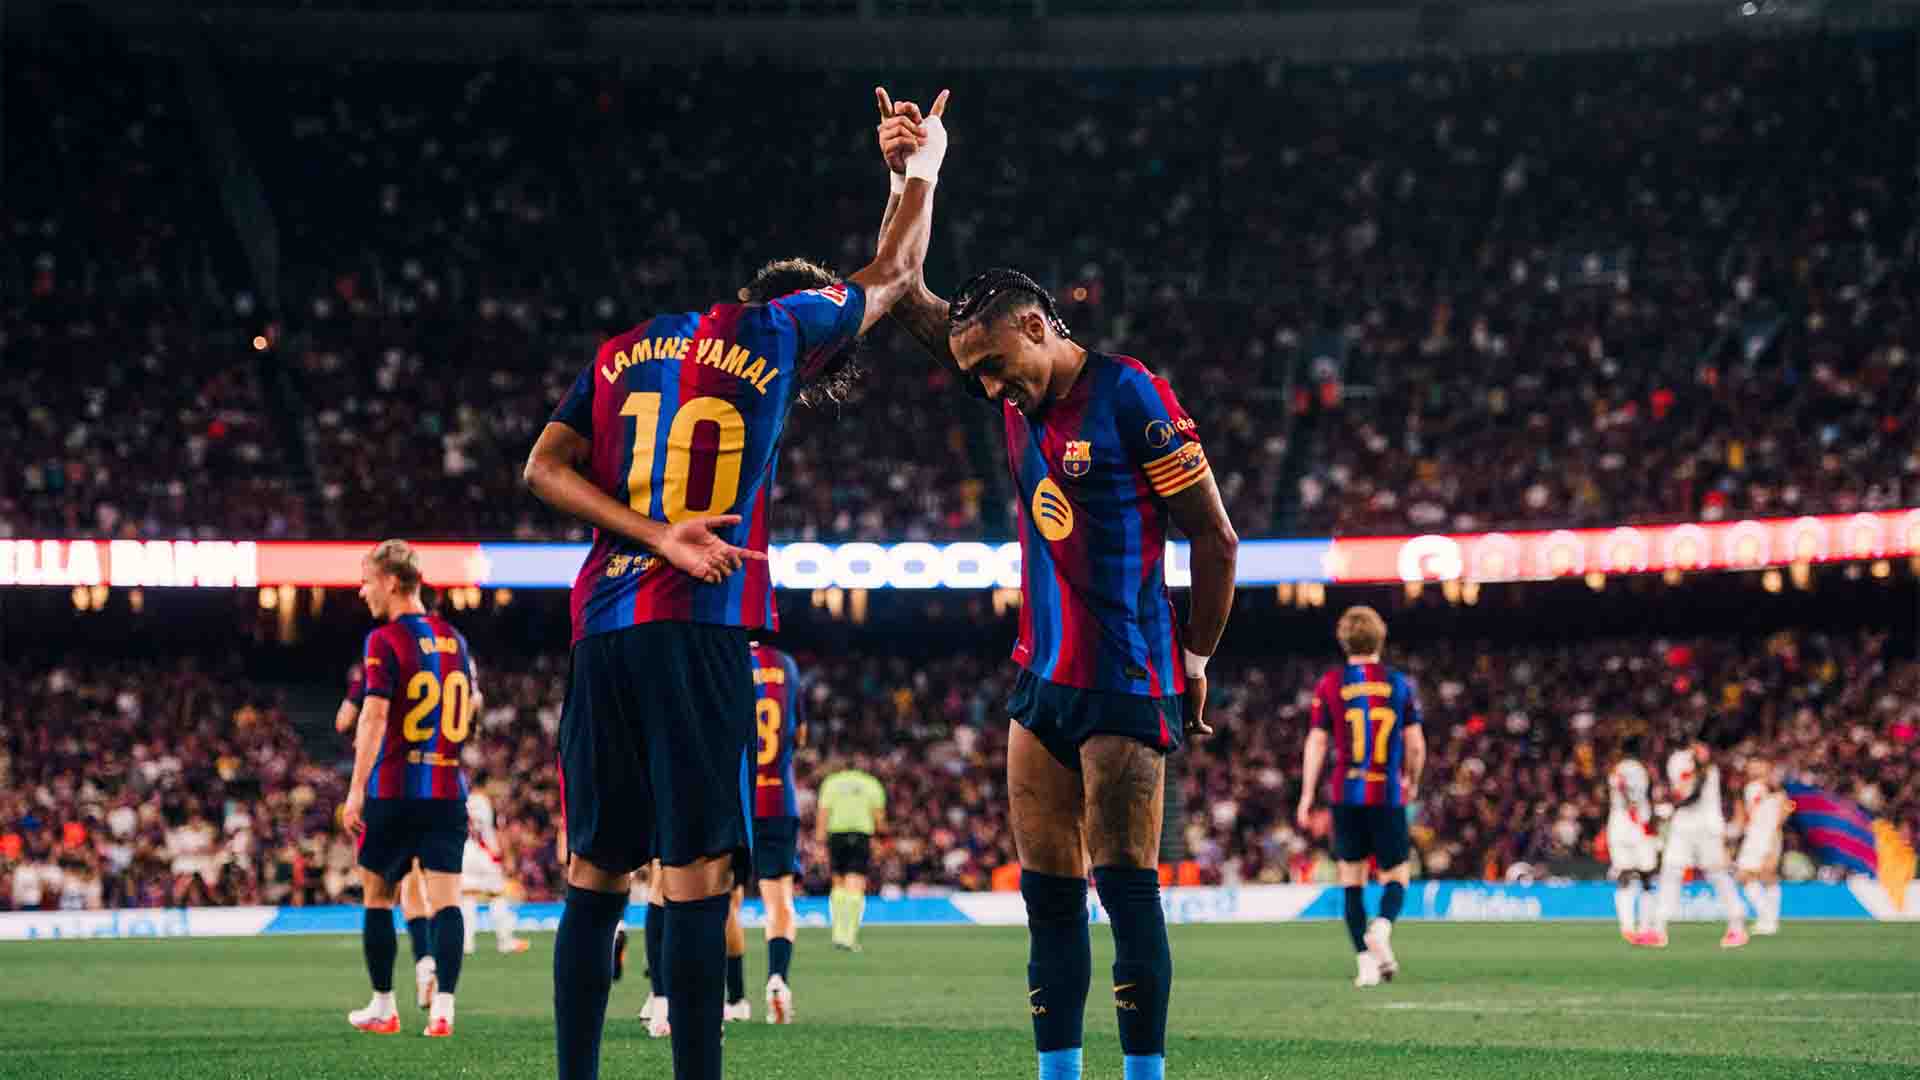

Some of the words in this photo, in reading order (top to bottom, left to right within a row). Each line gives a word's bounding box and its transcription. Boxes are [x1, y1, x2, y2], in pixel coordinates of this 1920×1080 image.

[601, 336, 693, 384] LAMINE
[695, 337, 779, 395] YAMAL
[619, 391, 745, 524] 10
[403, 671, 469, 743] 20
[1344, 706, 1397, 764] 17
